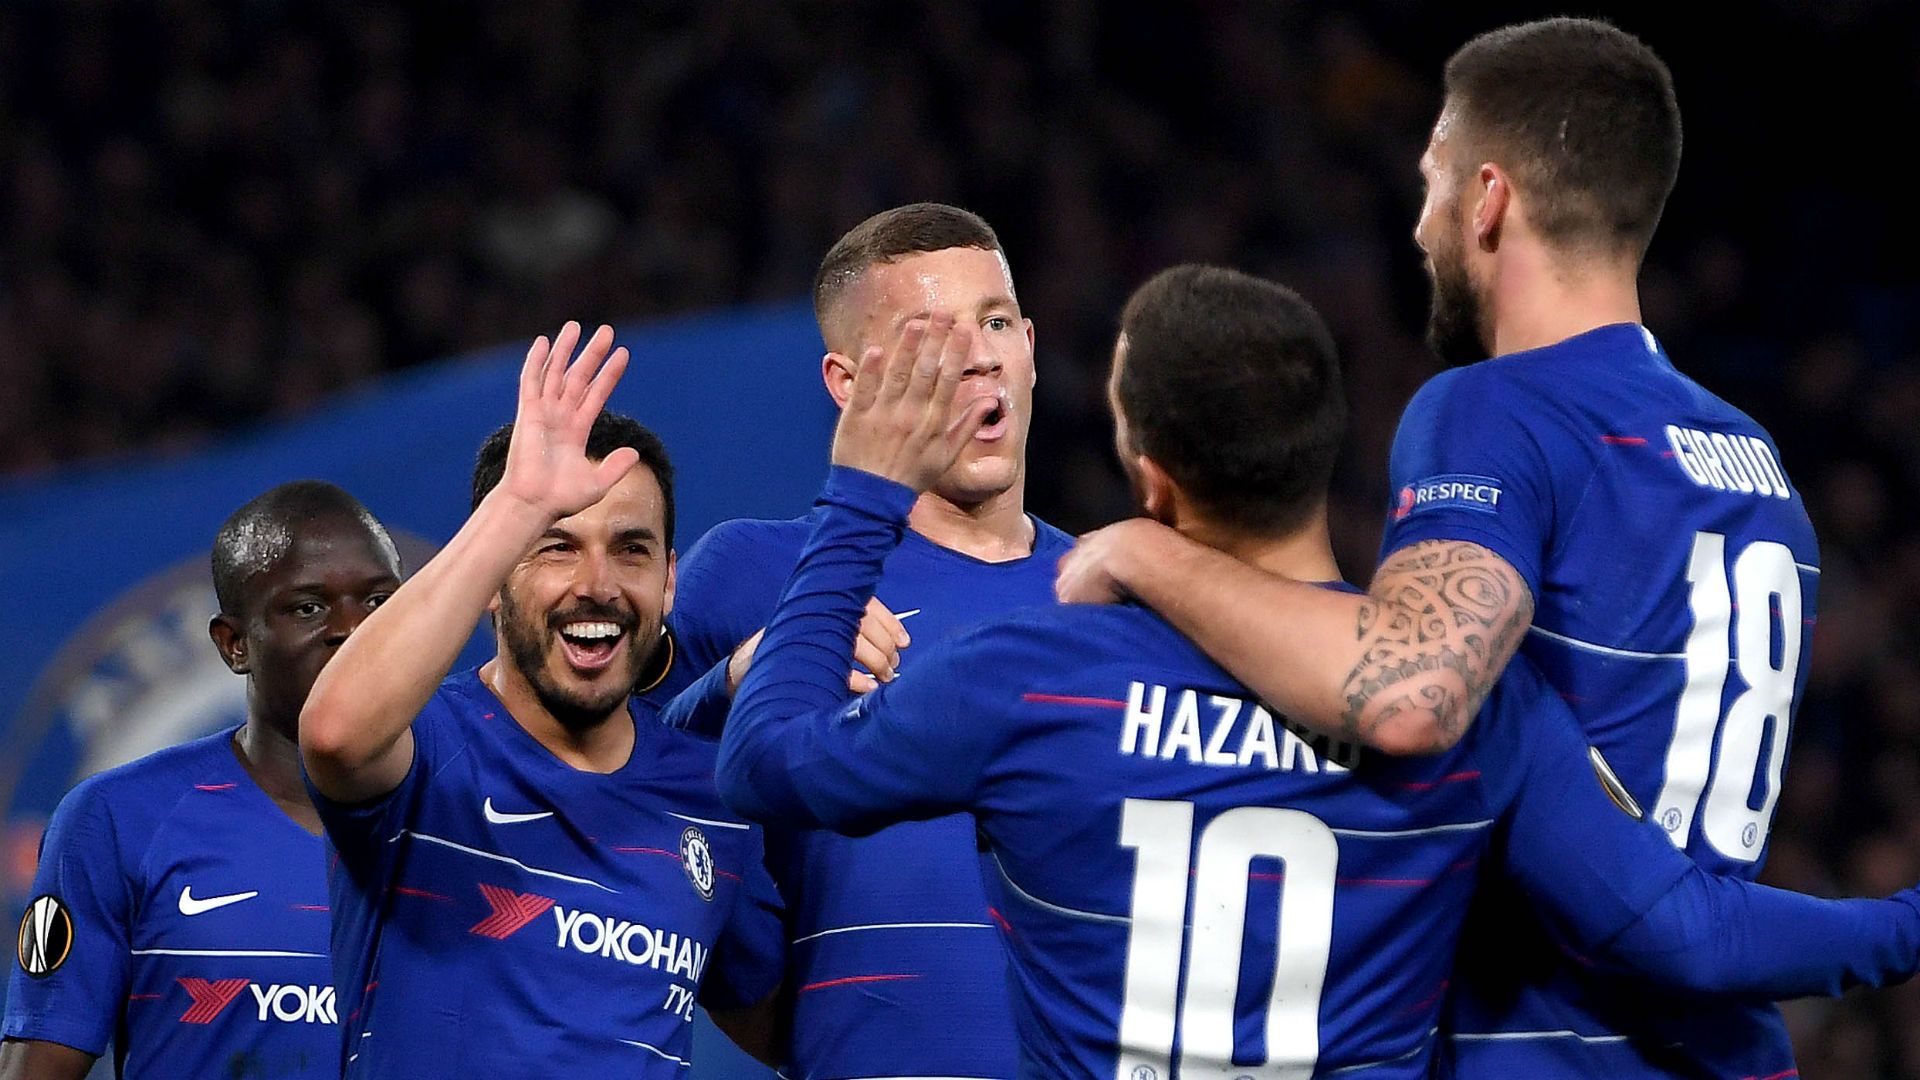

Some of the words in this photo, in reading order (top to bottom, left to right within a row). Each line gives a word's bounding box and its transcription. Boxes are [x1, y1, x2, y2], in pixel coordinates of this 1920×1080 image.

[1416, 482, 1502, 505] RESPECT
[1665, 424, 1791, 499] GIROUD
[1652, 530, 1802, 862] 18
[1113, 797, 1340, 1080] 10
[249, 983, 339, 1025] YOK
